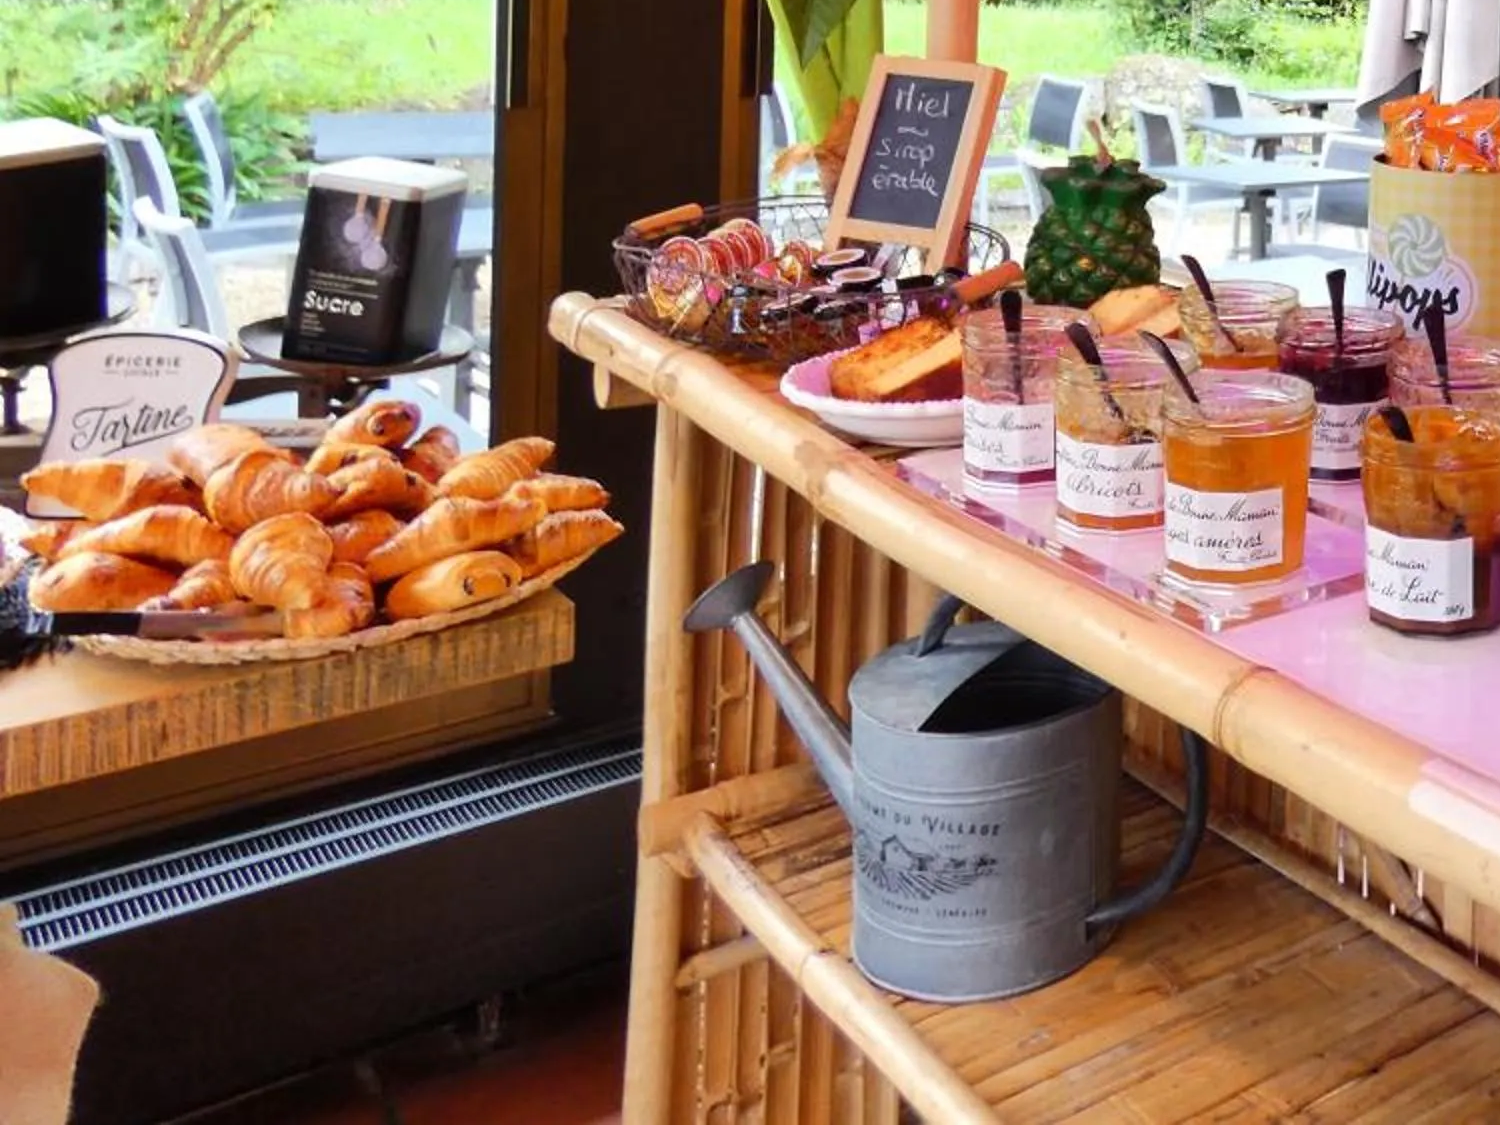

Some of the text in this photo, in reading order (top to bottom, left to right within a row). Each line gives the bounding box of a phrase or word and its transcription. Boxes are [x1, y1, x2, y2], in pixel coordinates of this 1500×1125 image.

[895, 82, 949, 117] Miel
[303, 290, 364, 316] Sucre
[1367, 259, 1460, 331] lipops
[71, 396, 194, 457] Tartine
[1222, 496, 1280, 522] Maman
